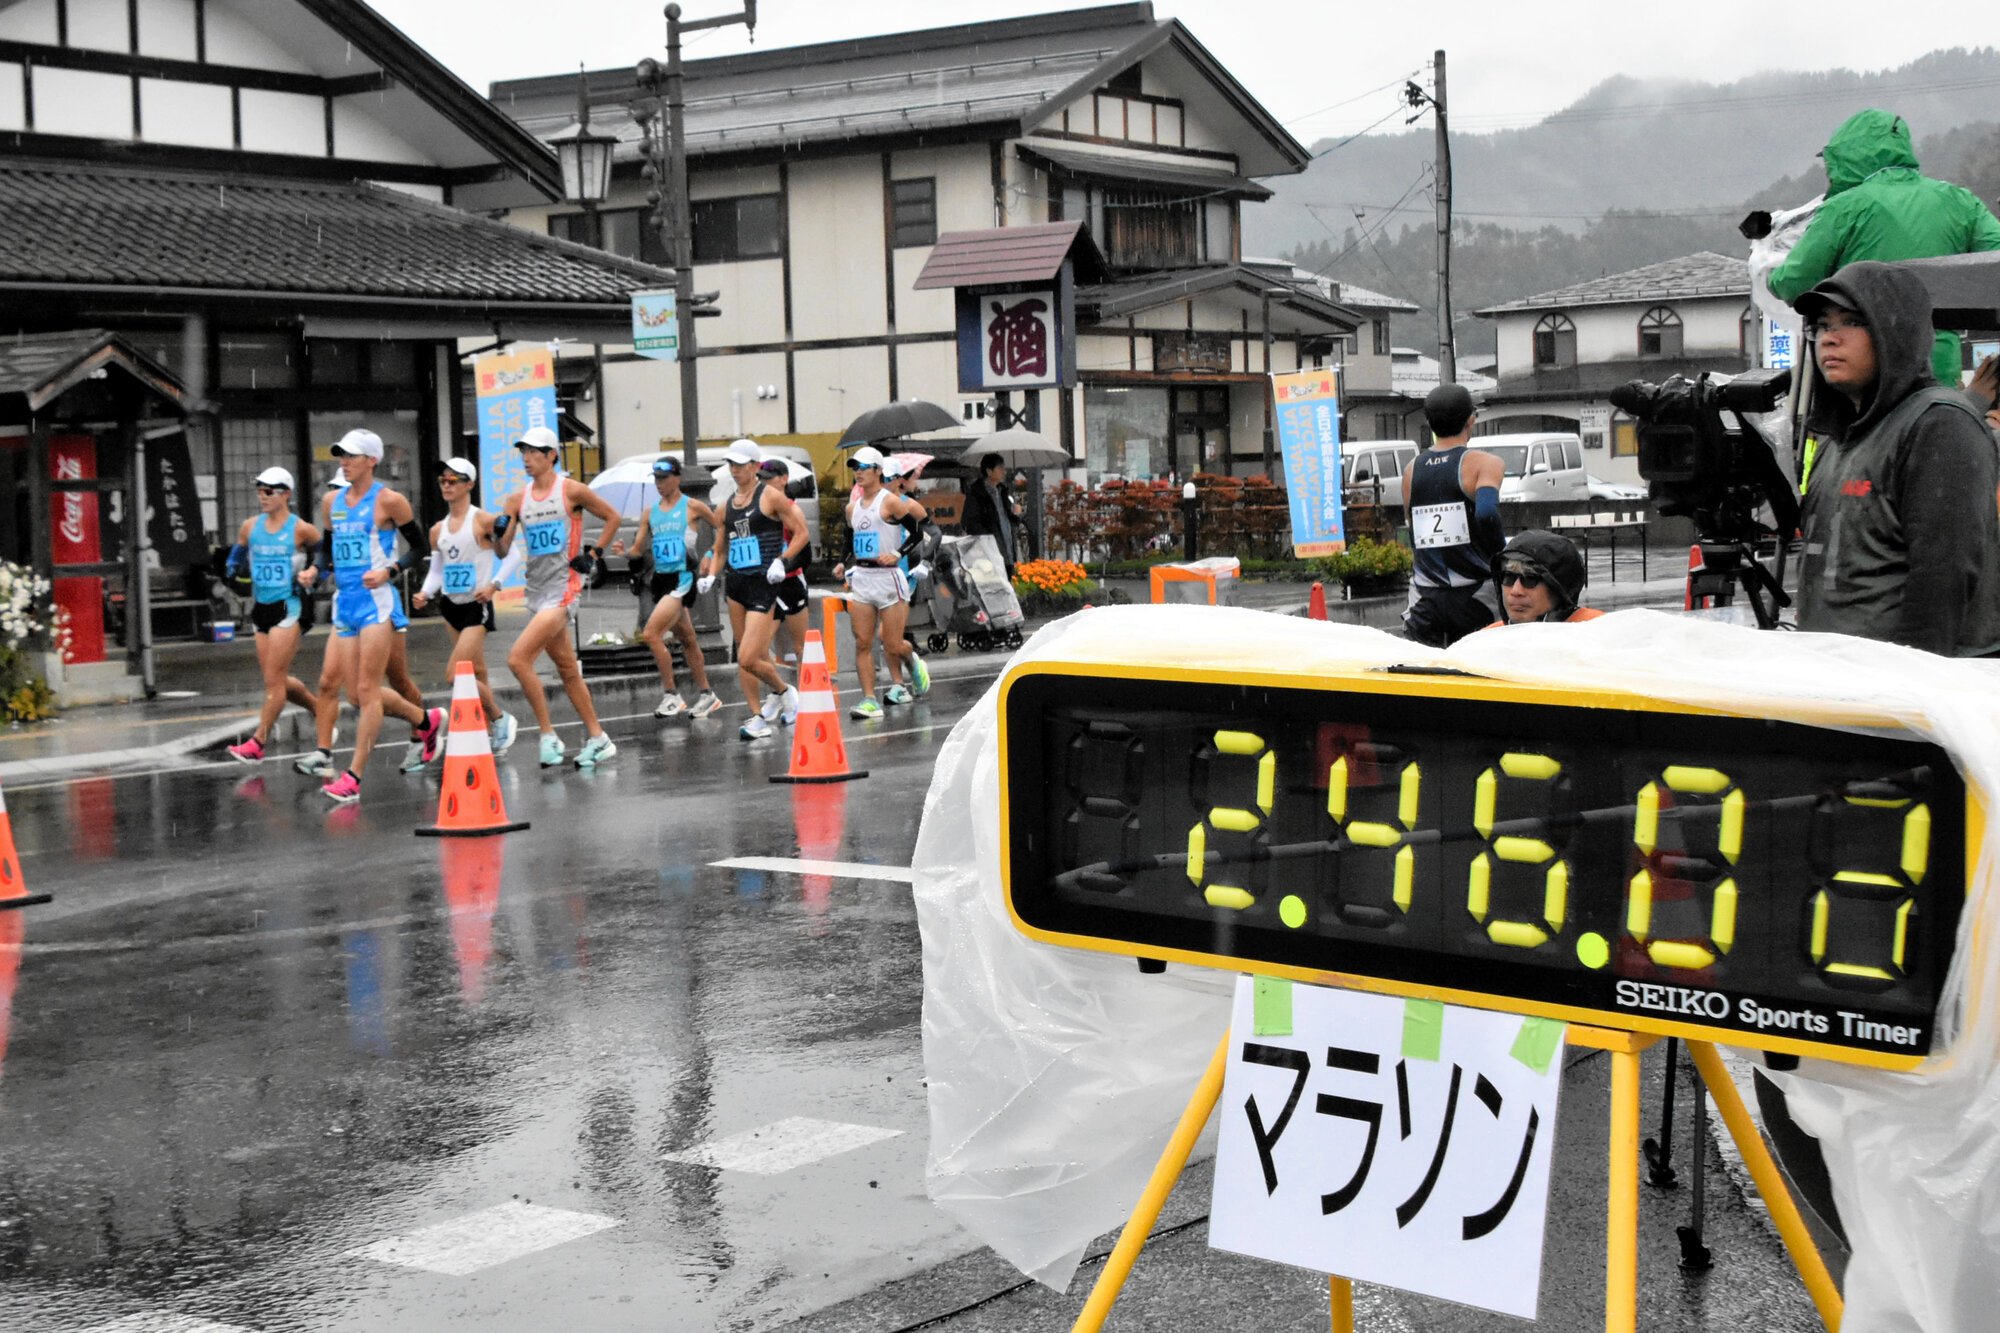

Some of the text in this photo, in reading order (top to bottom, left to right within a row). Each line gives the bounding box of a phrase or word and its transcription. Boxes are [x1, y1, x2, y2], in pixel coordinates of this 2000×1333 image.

[988, 298, 1048, 378] 酒
[1433, 513, 1443, 533] 2
[529, 528, 560, 550] 206
[653, 542, 677, 560] 241
[730, 544, 752, 563] 211
[1616, 979, 1922, 1047] SEIKO Sports Timer
[1242, 1041, 1540, 1241] マラソン
